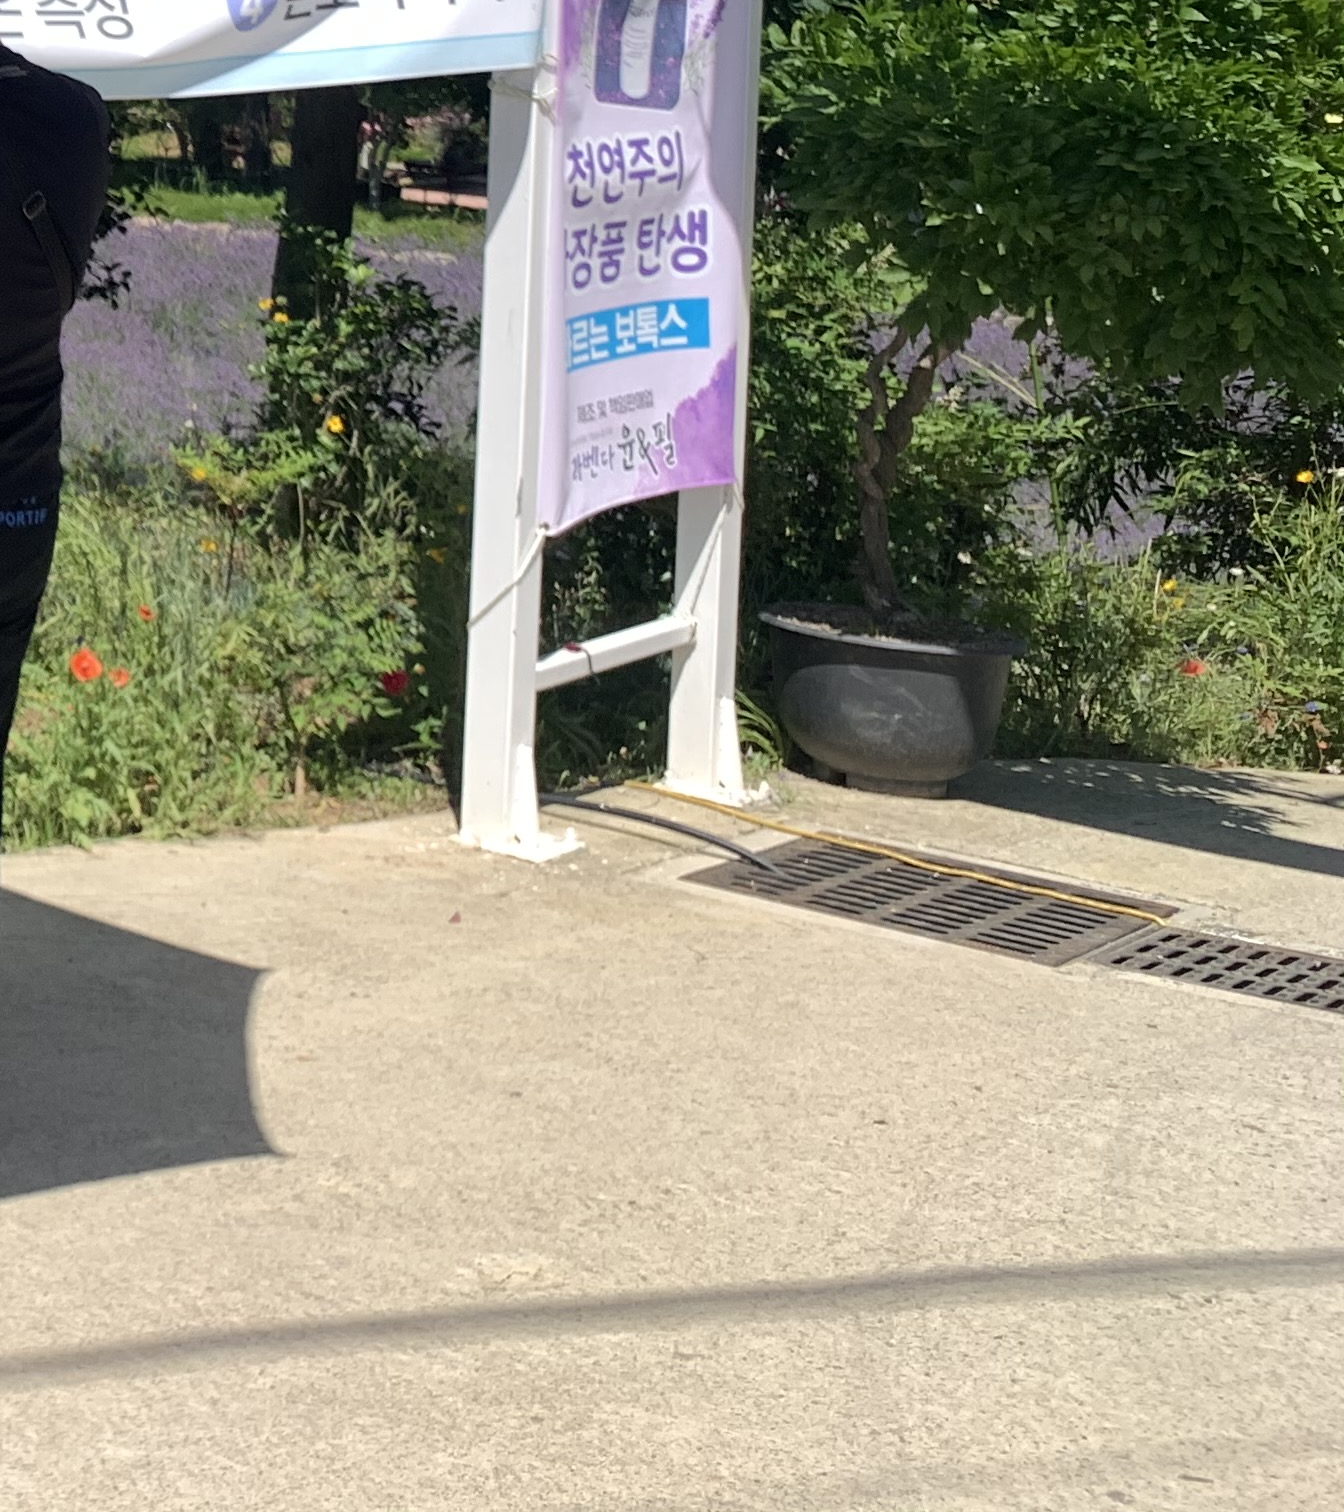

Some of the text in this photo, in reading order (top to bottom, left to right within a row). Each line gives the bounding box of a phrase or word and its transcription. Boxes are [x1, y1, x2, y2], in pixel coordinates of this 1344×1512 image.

[567, 130, 684, 208] 천연주의
[564, 209, 708, 289] 장품 탄생
[566, 303, 688, 368] 르는 보톡스
